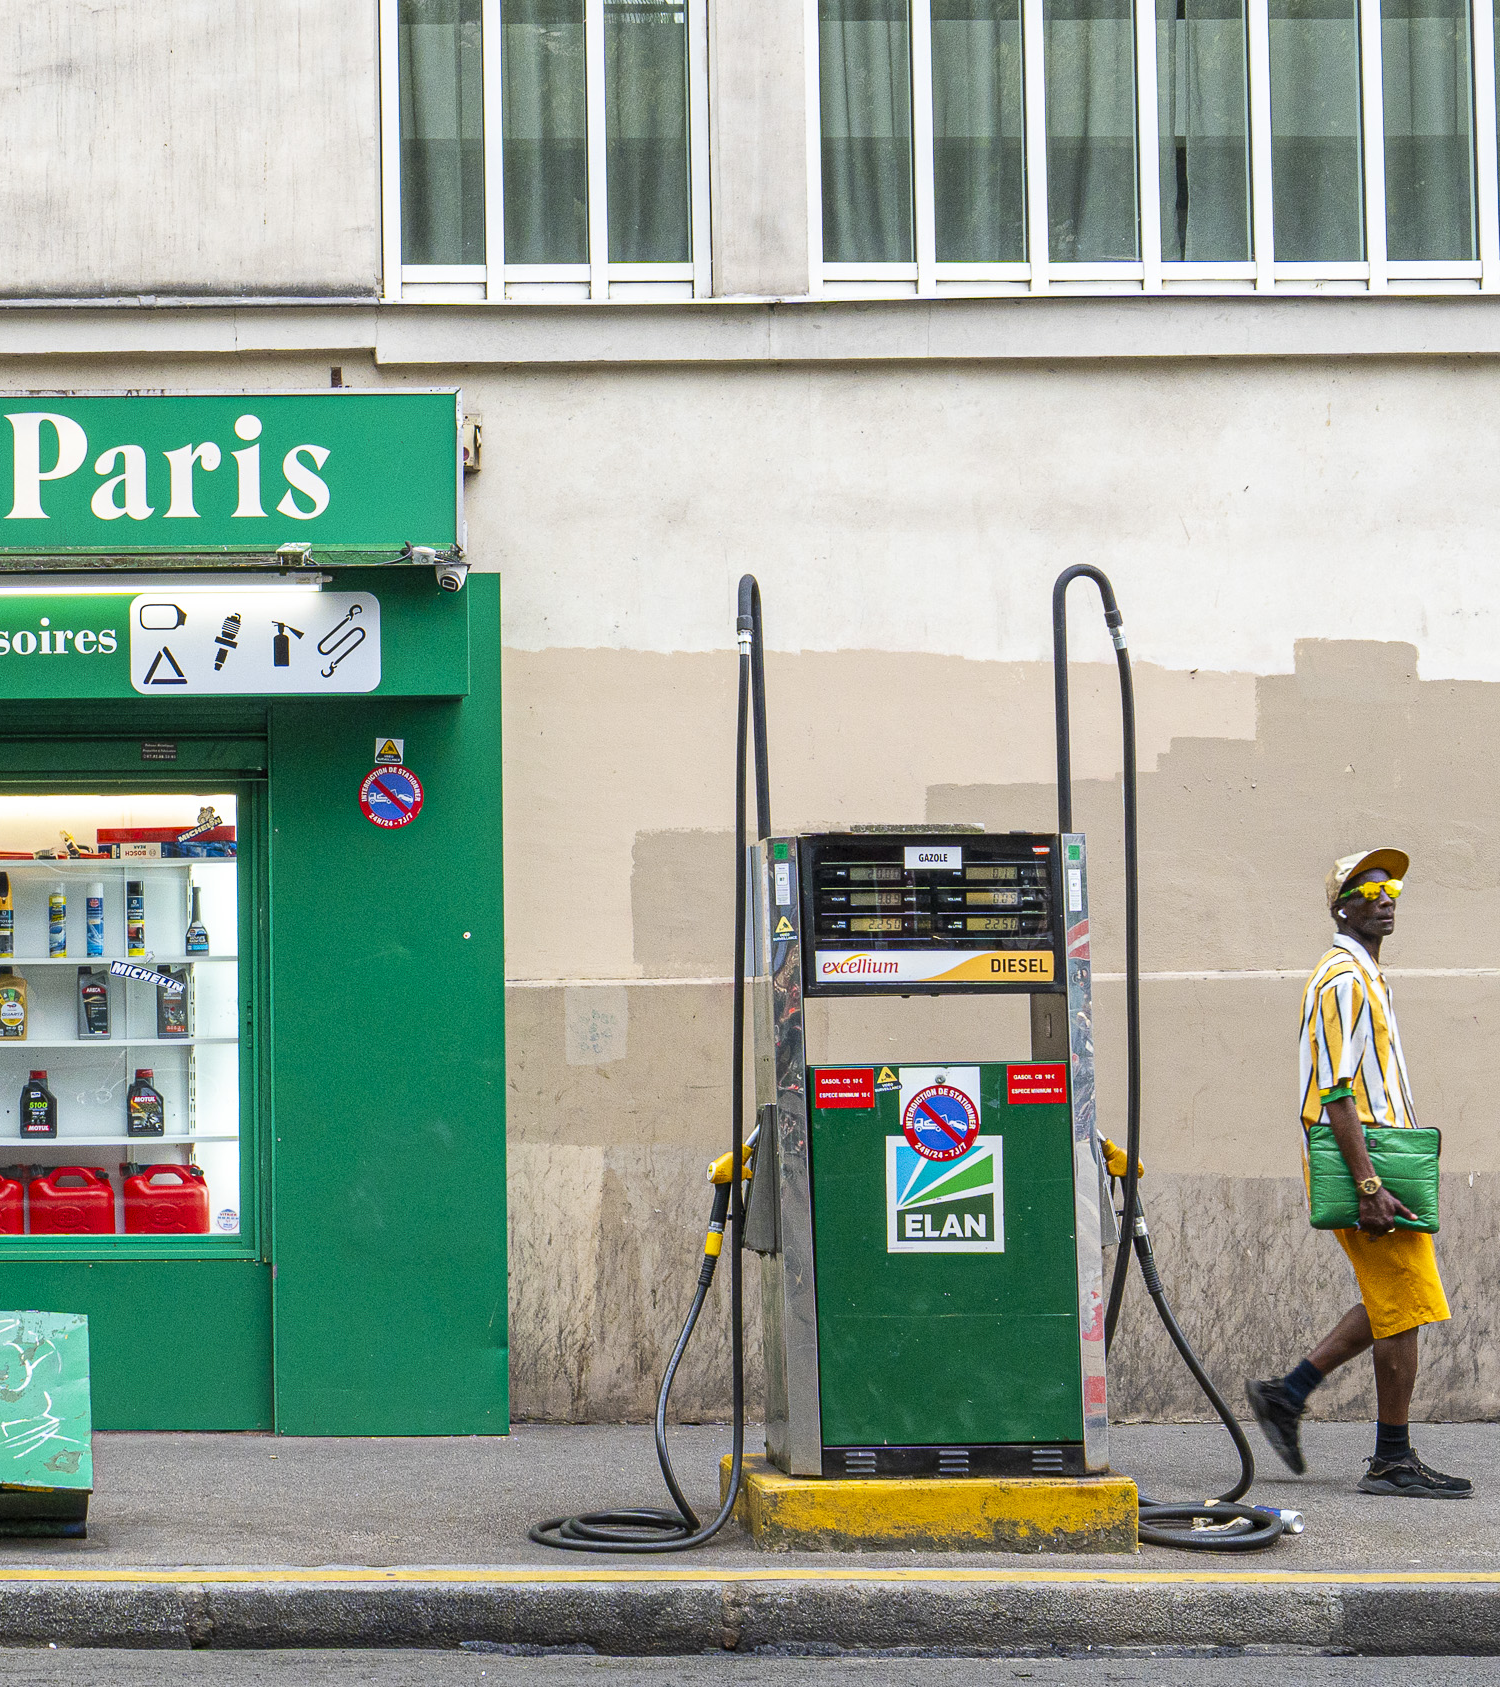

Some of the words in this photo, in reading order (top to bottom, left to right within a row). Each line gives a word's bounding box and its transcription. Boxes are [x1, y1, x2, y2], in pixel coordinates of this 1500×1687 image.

[3, 411, 332, 521] Paris
[361, 767, 388, 802] INTERDICTION
[398, 768, 422, 802] STATIONNER
[368, 812, 393, 826] 24H/24
[398, 812, 413, 826] 7J/7
[918, 853, 948, 862] GAZOLE
[822, 956, 900, 974] excellium
[990, 958, 1048, 974] DIESEL
[111, 962, 184, 992] MICHELIN
[906, 1088, 937, 1130] INTERDICTION
[948, 1090, 976, 1130] STATIONNER
[914, 1142, 944, 1158] 24H/24
[949, 1142, 967, 1156] 7J/7
[904, 1214, 986, 1238] ELAN
